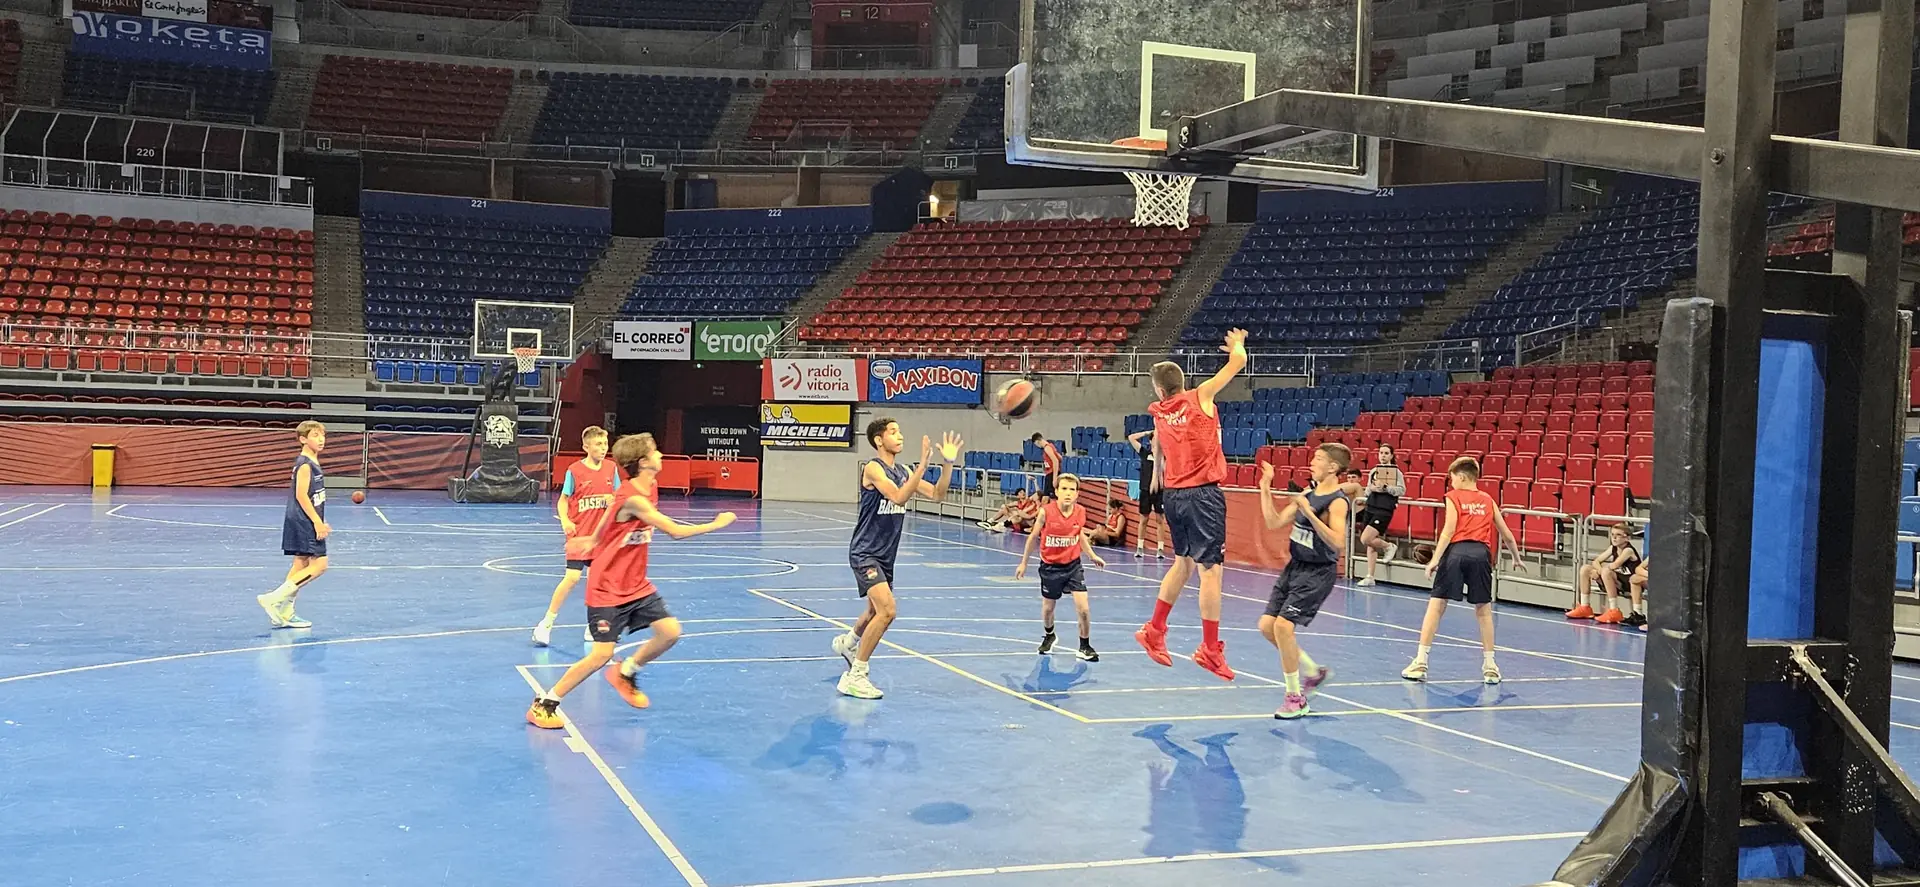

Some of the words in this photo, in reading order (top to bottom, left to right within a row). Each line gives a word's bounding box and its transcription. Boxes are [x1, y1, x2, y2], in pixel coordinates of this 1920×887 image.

[144, 1, 154, 9] El
[155, 2, 175, 12] Corte
[864, 6, 879, 19] 12
[115, 19, 265, 48] oketa
[115, 34, 265, 55] rotulación
[136, 147, 155, 157] 220
[1376, 187, 1394, 197] 224
[471, 200, 487, 208] 221
[768, 208, 782, 217] 222
[614, 332, 629, 344] EL
[631, 332, 685, 345] CORREO
[807, 363, 842, 378] radio
[807, 378, 850, 392] vitoria
[884, 366, 979, 400] MAXIBON
[700, 427, 720, 435] NEVER
[720, 427, 729, 435] GO
[766, 425, 846, 438] MICHELIN
[708, 437, 734, 445] WITHOUT
[735, 438, 740, 446] A
